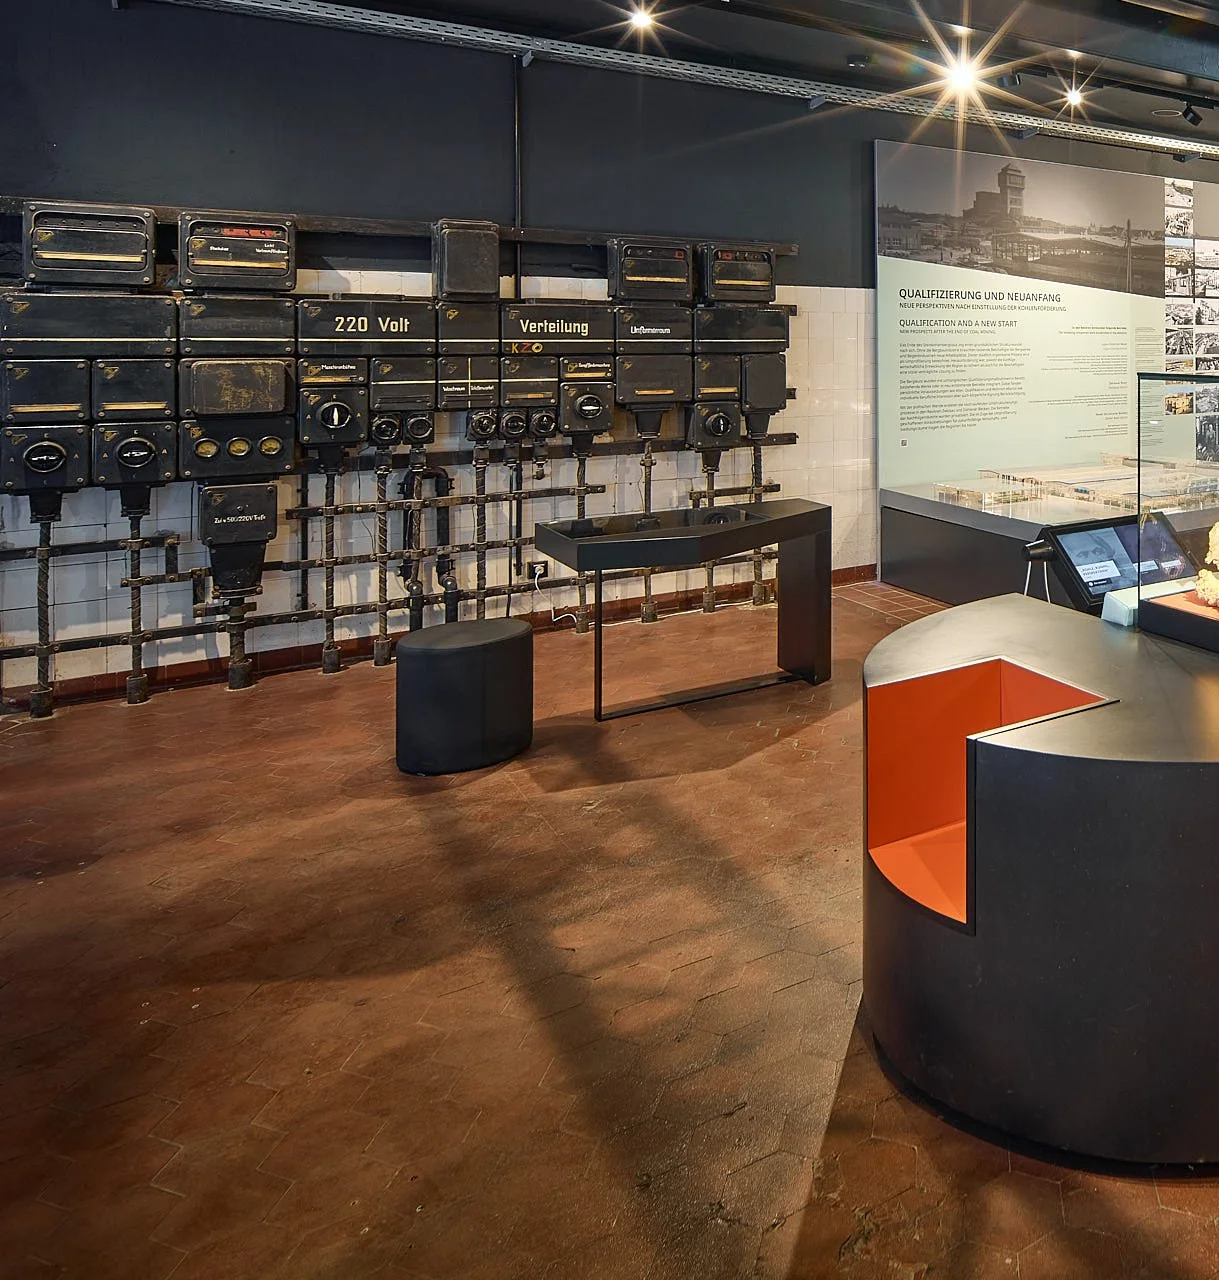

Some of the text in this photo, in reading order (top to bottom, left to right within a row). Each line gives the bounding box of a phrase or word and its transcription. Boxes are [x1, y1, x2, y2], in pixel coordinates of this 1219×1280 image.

[899, 288, 1061, 303] QUALIFIZIERUNG UND NEUANFANG
[335, 316, 410, 332] 220 Volt
[520, 319, 589, 336] Verteilung
[899, 319, 956, 328] QUALIFICATION
[998, 320, 1018, 328] START
